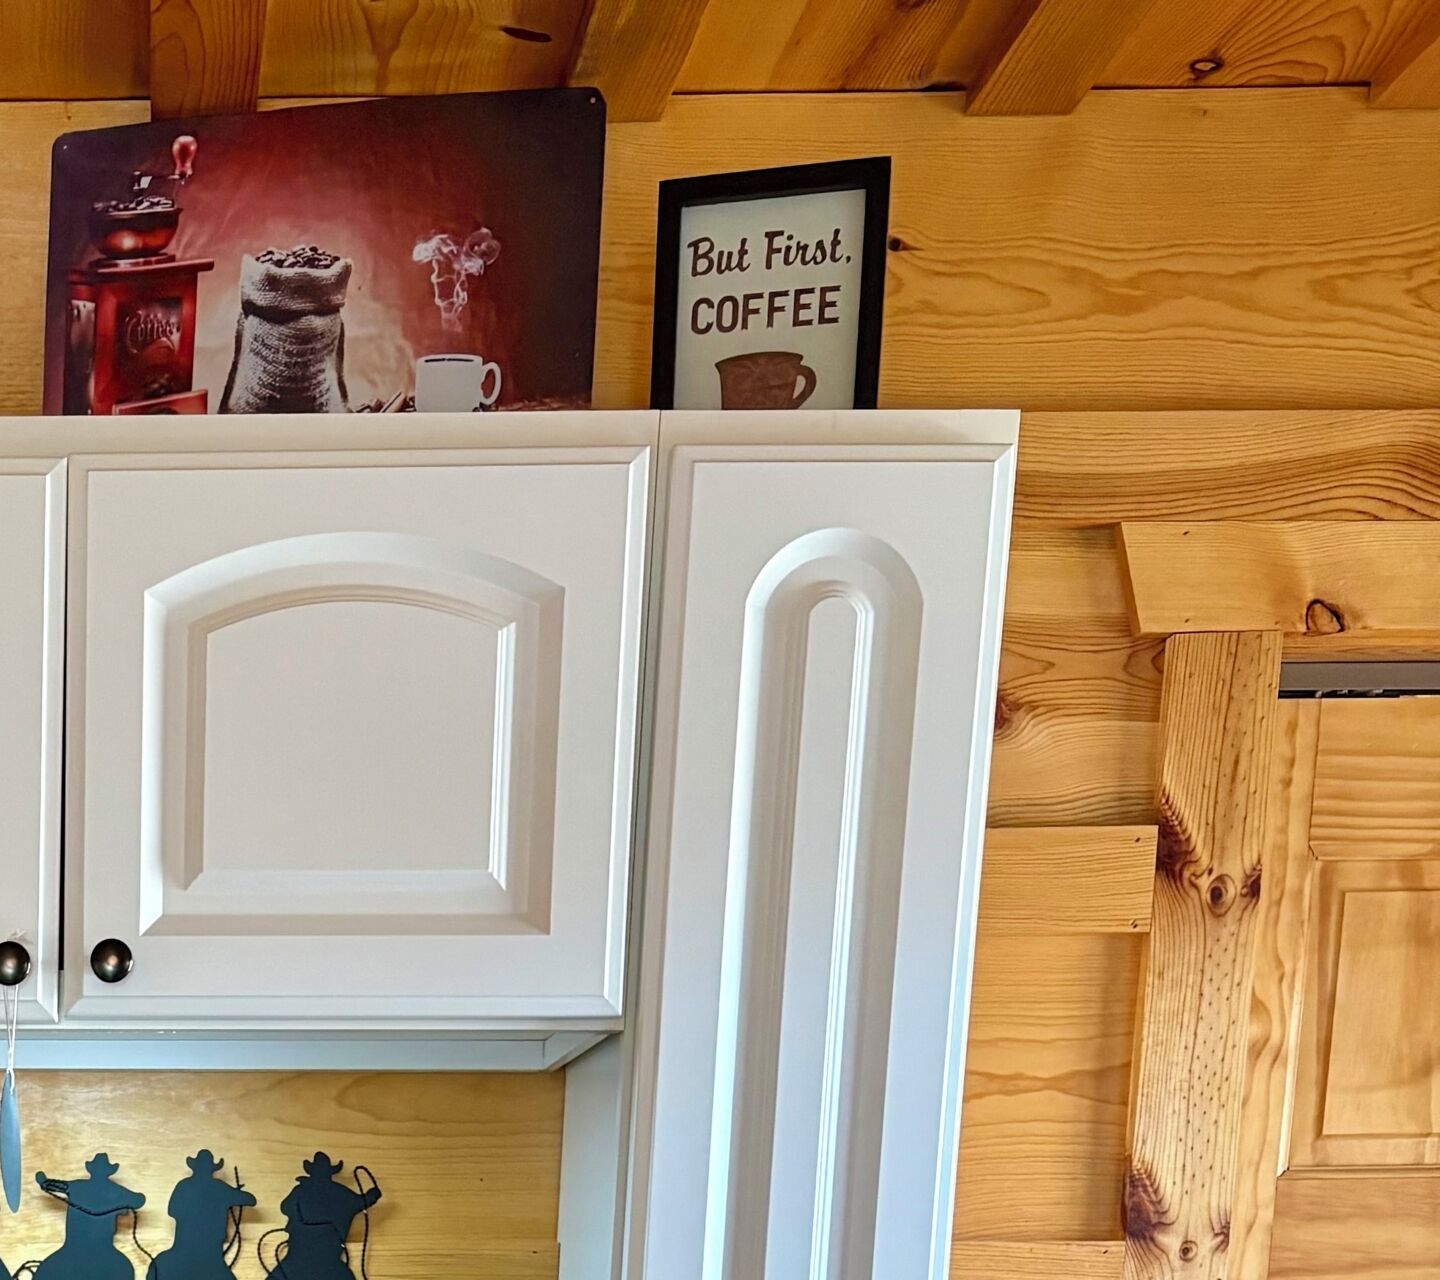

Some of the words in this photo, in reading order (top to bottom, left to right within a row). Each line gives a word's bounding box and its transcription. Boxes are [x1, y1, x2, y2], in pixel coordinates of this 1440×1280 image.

[687, 236, 751, 277] But
[764, 228, 852, 270] First,
[690, 285, 842, 335] COFFEE
